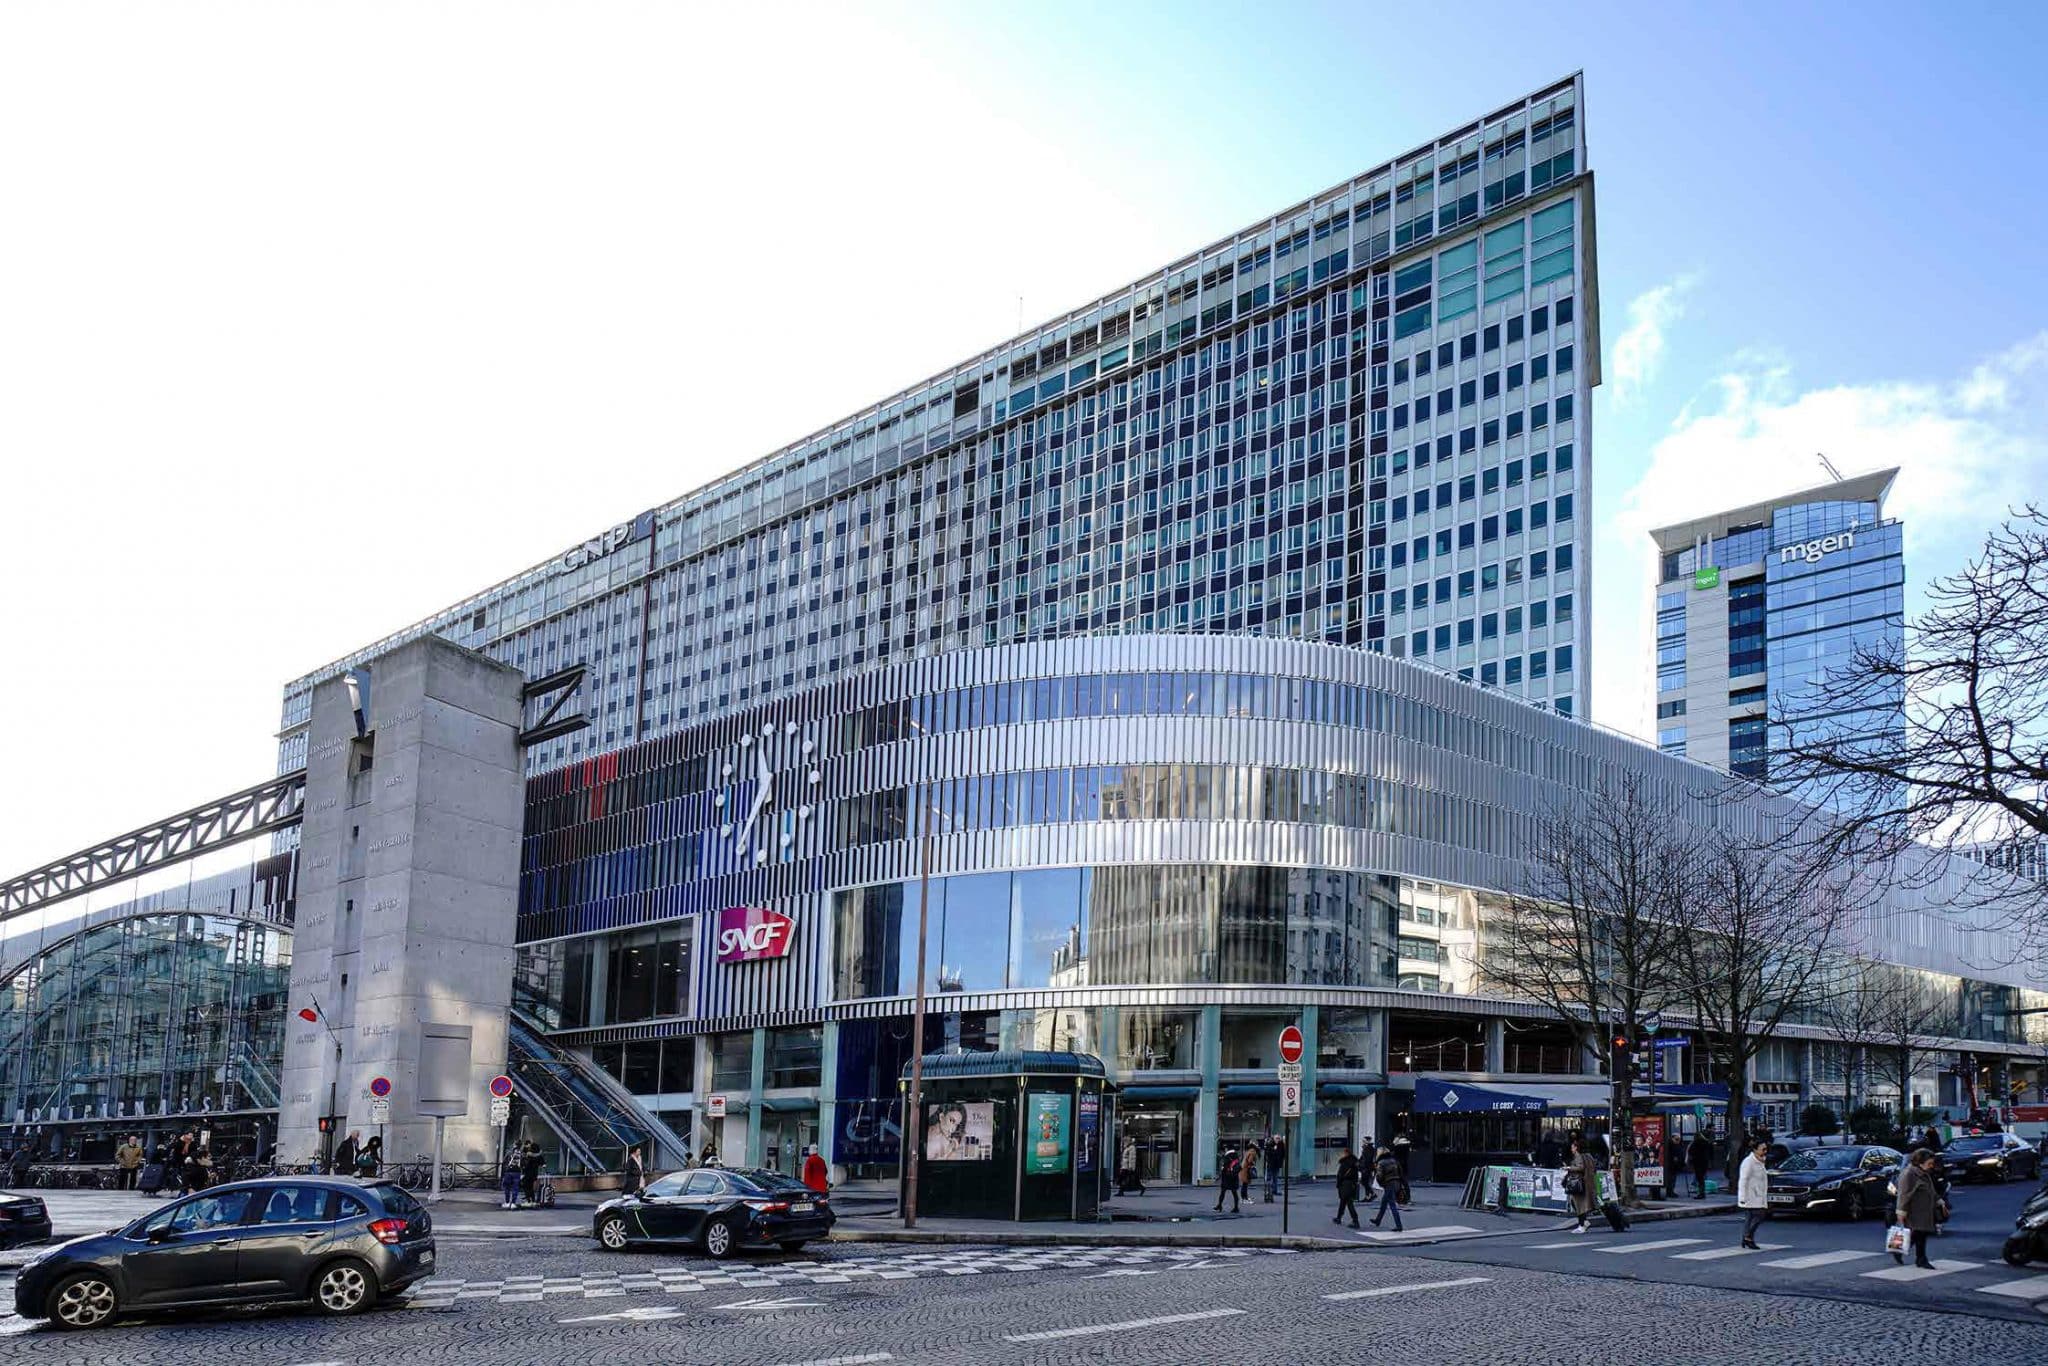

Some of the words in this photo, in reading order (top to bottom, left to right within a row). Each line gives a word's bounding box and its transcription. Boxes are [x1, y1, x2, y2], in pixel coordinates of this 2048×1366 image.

[562, 523, 630, 569] CNP
[1781, 531, 1854, 563] mgen
[1695, 574, 1716, 586] mgen
[717, 921, 787, 956] SNCF
[15, 1094, 234, 1124] MONTPARNASSE
